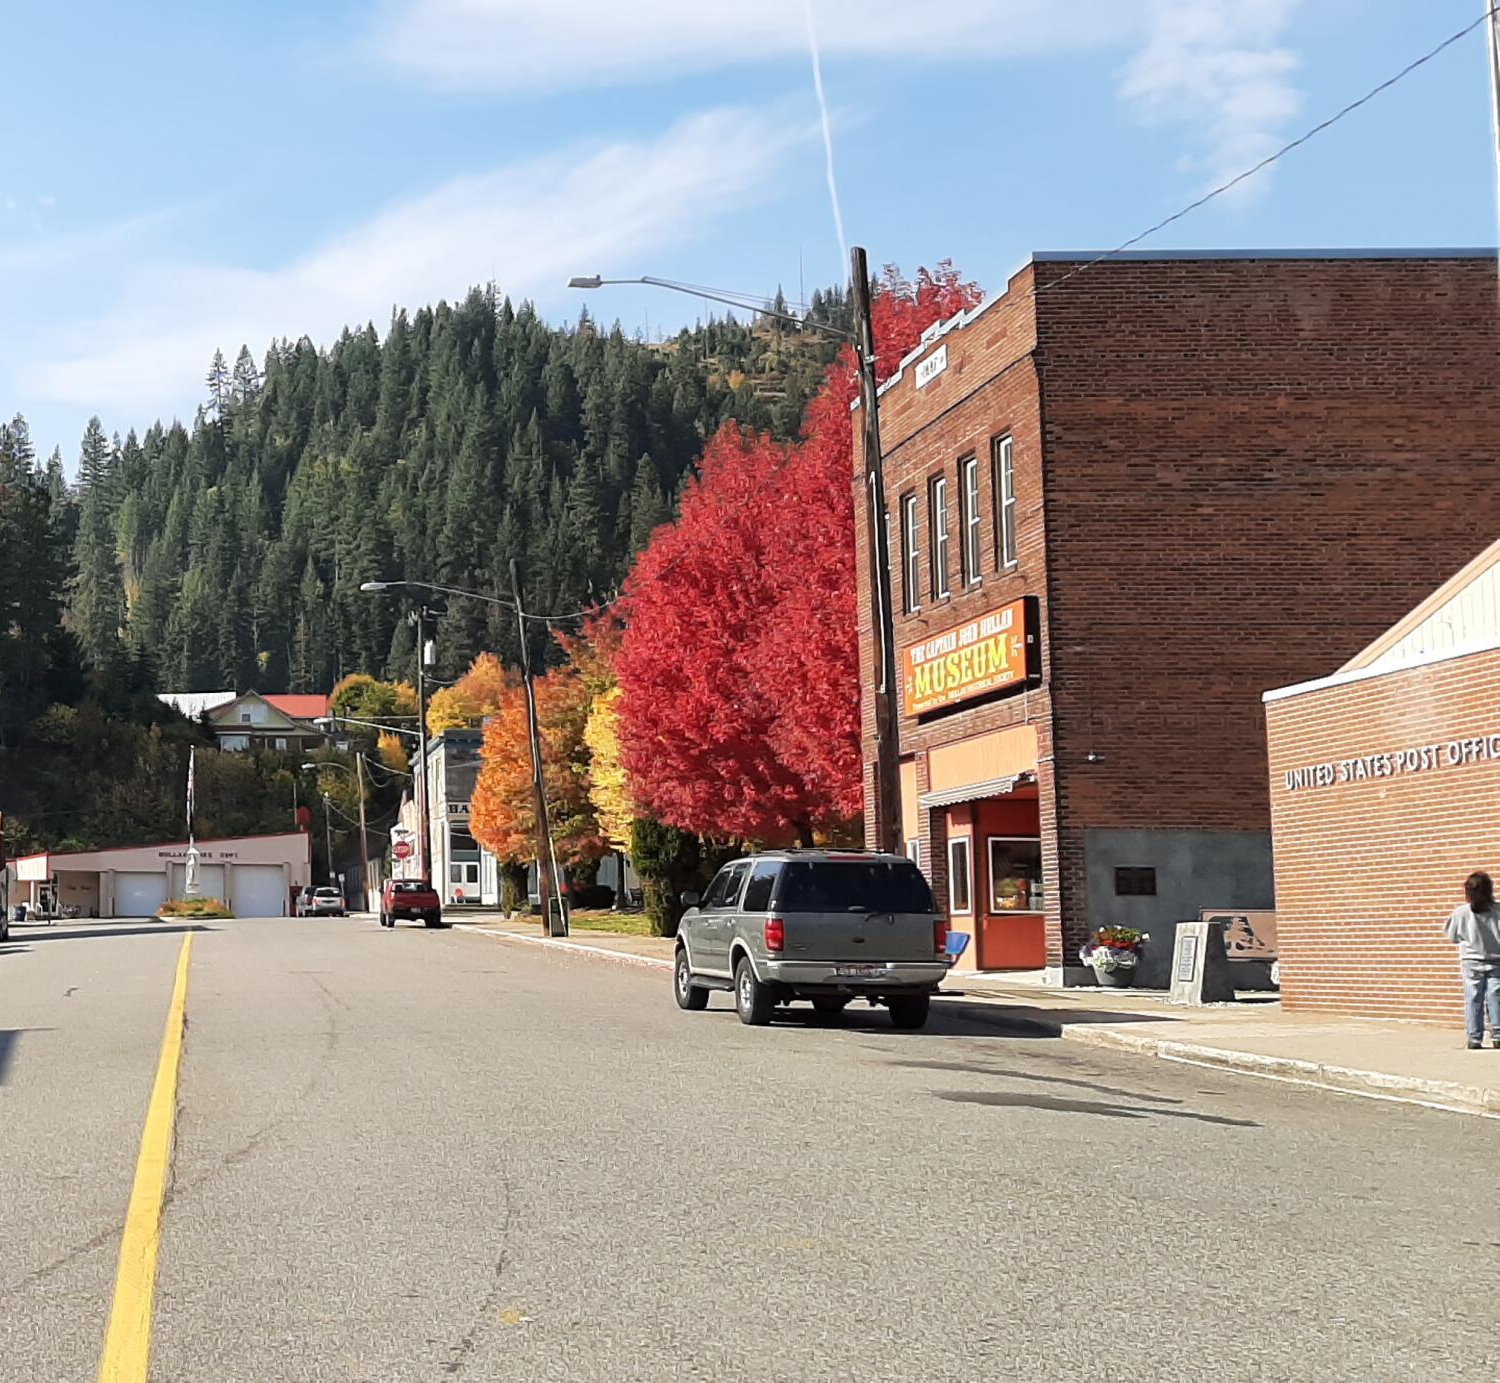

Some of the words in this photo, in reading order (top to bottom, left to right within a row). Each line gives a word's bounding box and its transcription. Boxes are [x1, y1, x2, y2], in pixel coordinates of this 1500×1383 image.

[914, 633, 1009, 699] MUSEUM
[1285, 763, 1336, 790] UNITED
[1340, 754, 1394, 782] STATES
[1396, 745, 1441, 773] POST
